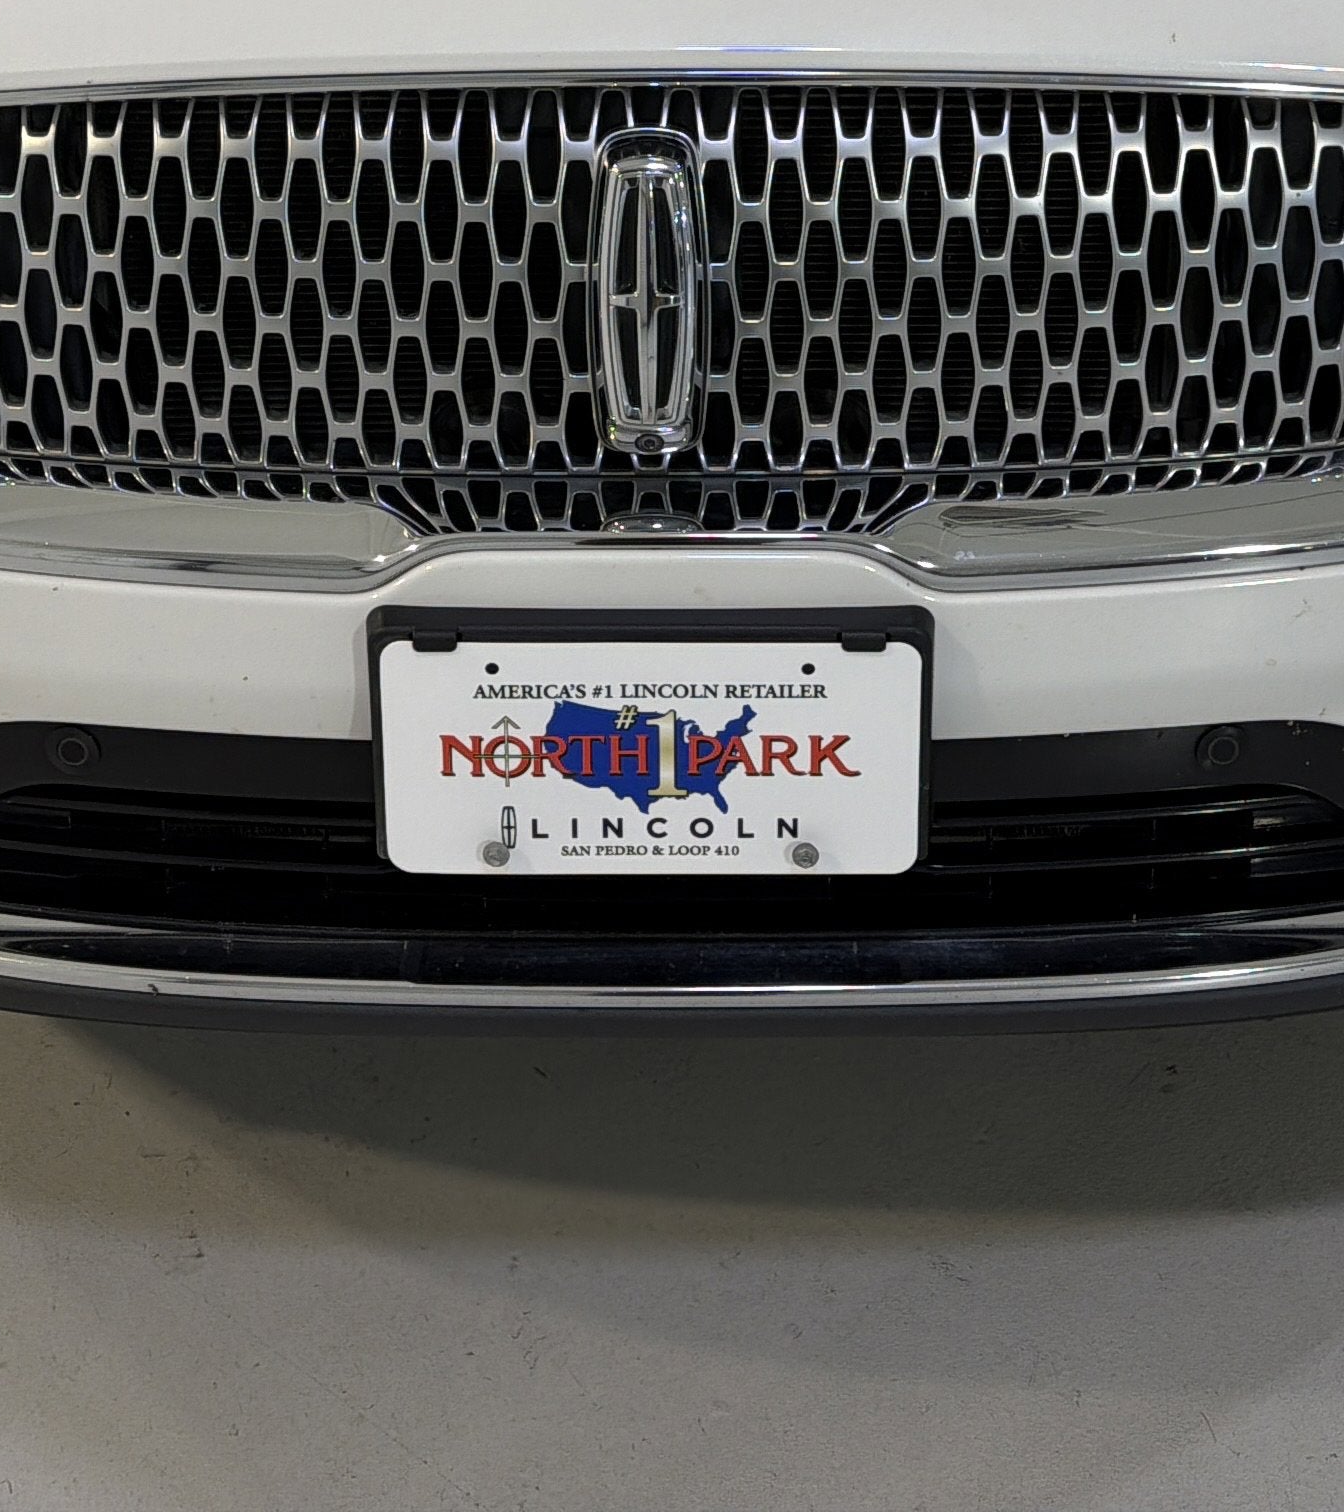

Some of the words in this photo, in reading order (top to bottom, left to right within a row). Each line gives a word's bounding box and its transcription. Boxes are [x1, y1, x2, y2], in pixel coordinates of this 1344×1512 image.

[472, 683, 587, 700] AMERICA'S
[591, 684, 614, 699] #1
[620, 684, 719, 699] LINCOLN
[724, 684, 828, 699] RETAILER
[439, 734, 650, 778] NORTH
[687, 734, 862, 777] PARK
[531, 817, 799, 839] LINCOLN
[560, 845, 591, 857] SAN
[595, 845, 648, 856] PEDRO
[651, 845, 665, 856] &
[668, 845, 711, 857] LOOP
[714, 845, 740, 856] 410
